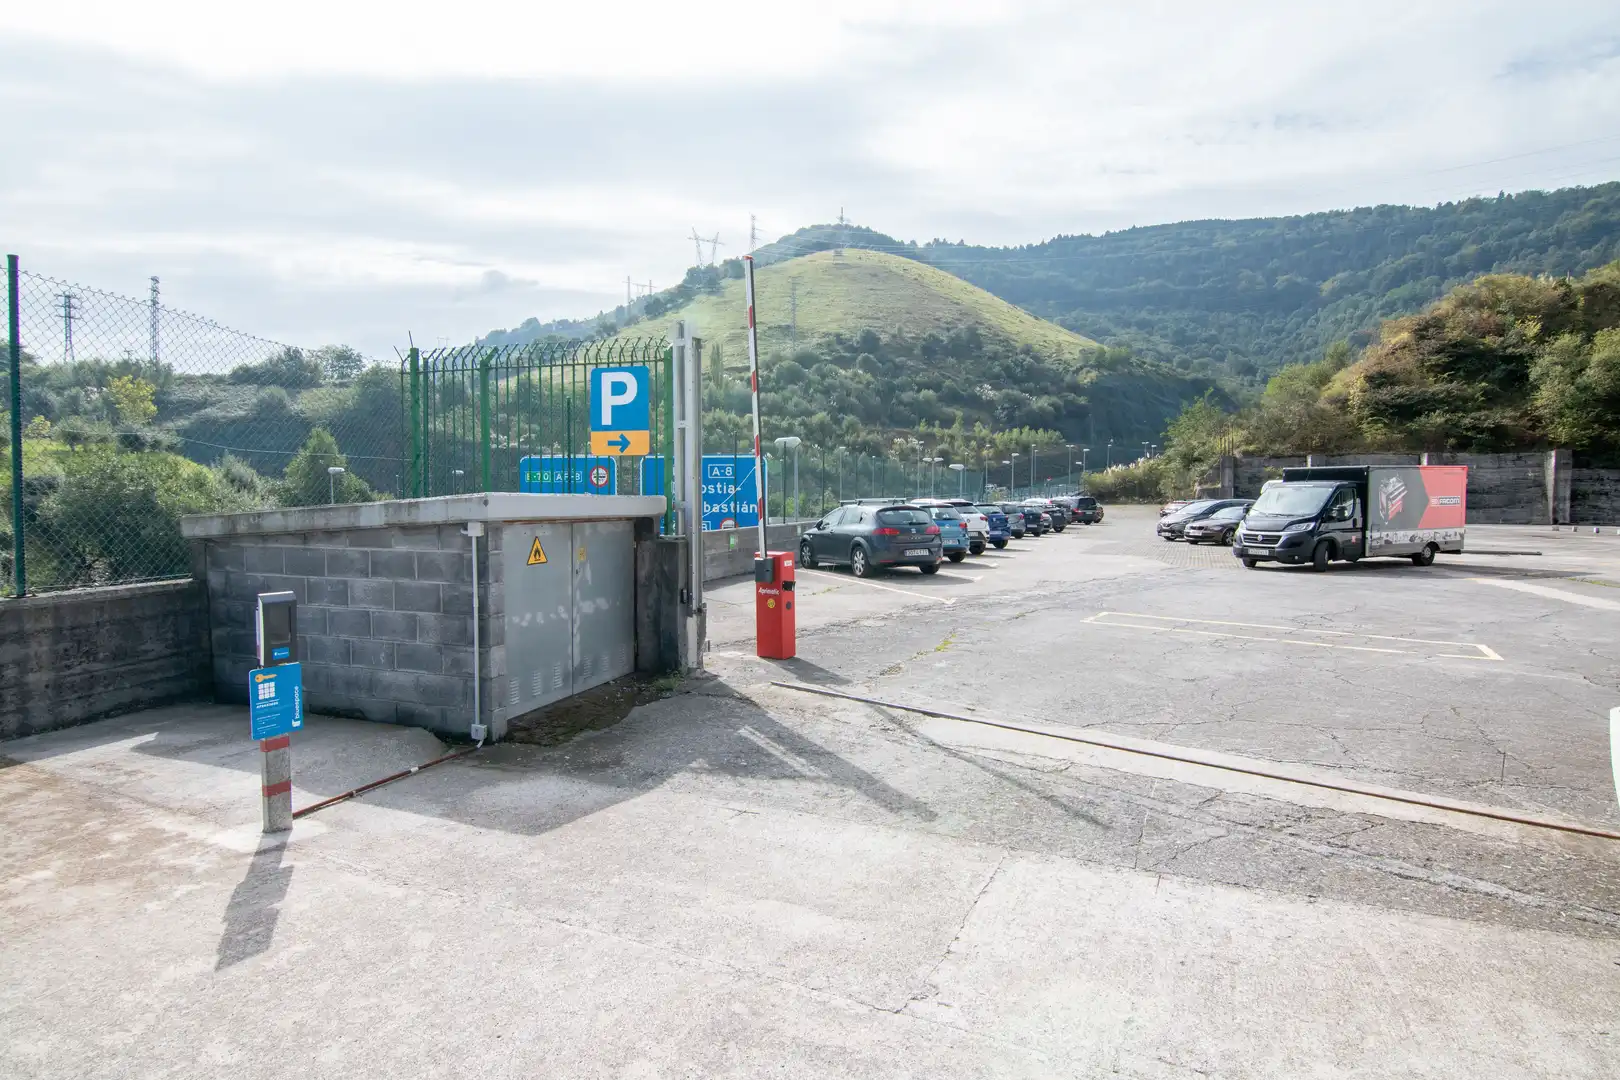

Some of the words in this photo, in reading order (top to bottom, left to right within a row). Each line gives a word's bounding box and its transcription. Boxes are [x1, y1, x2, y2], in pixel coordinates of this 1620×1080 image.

[601, 371, 638, 426] P
[712, 466, 733, 476] A-8
[703, 500, 758, 513] bastián
